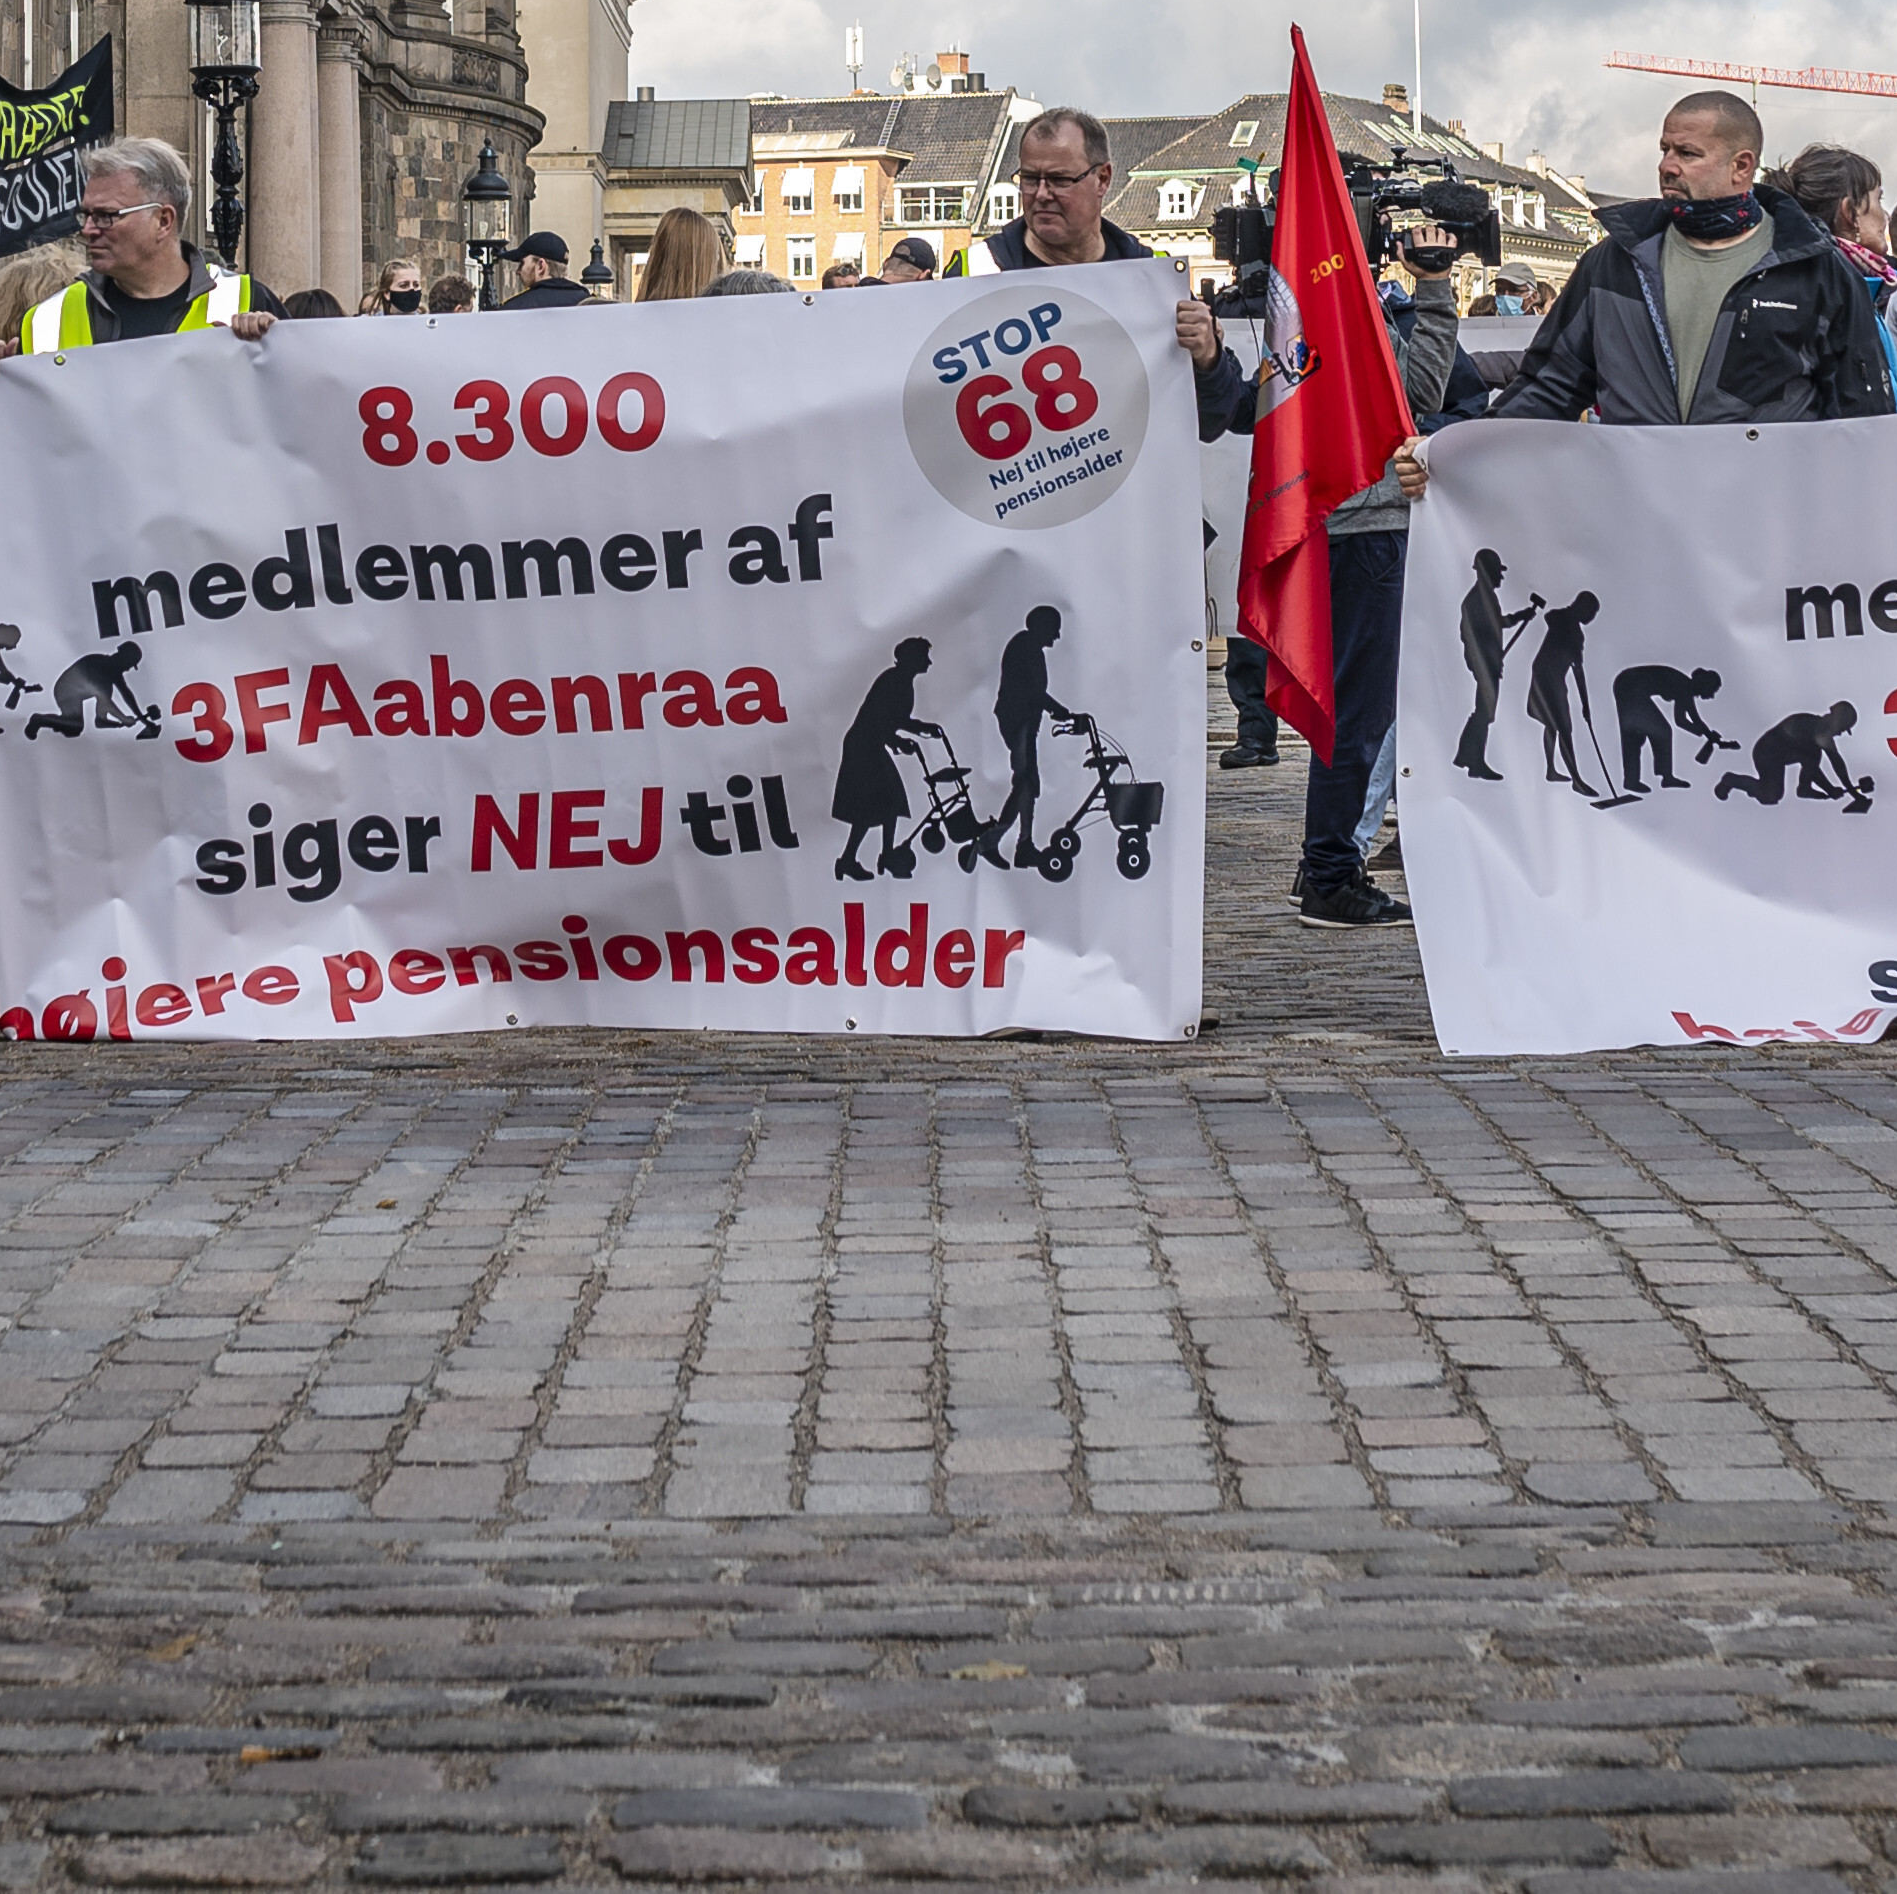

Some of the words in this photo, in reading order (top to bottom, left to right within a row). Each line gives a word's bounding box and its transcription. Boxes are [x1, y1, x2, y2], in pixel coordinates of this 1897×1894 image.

[1310, 253, 1345, 284] 200
[932, 302, 1062, 385] STOP
[359, 372, 665, 466] 8.300
[956, 345, 1099, 461] 68
[988, 465, 1026, 491] Nej
[1024, 453, 1048, 475] til
[1046, 427, 1111, 465] højere
[994, 448, 1124, 520] pensionsalder
[91, 523, 703, 639] medlemmer
[727, 493, 834, 585] af
[195, 802, 442, 903] siger
[472, 788, 663, 871] NEJ
[679, 774, 800, 857] til
[323, 903, 1025, 1022] pensionsalder
